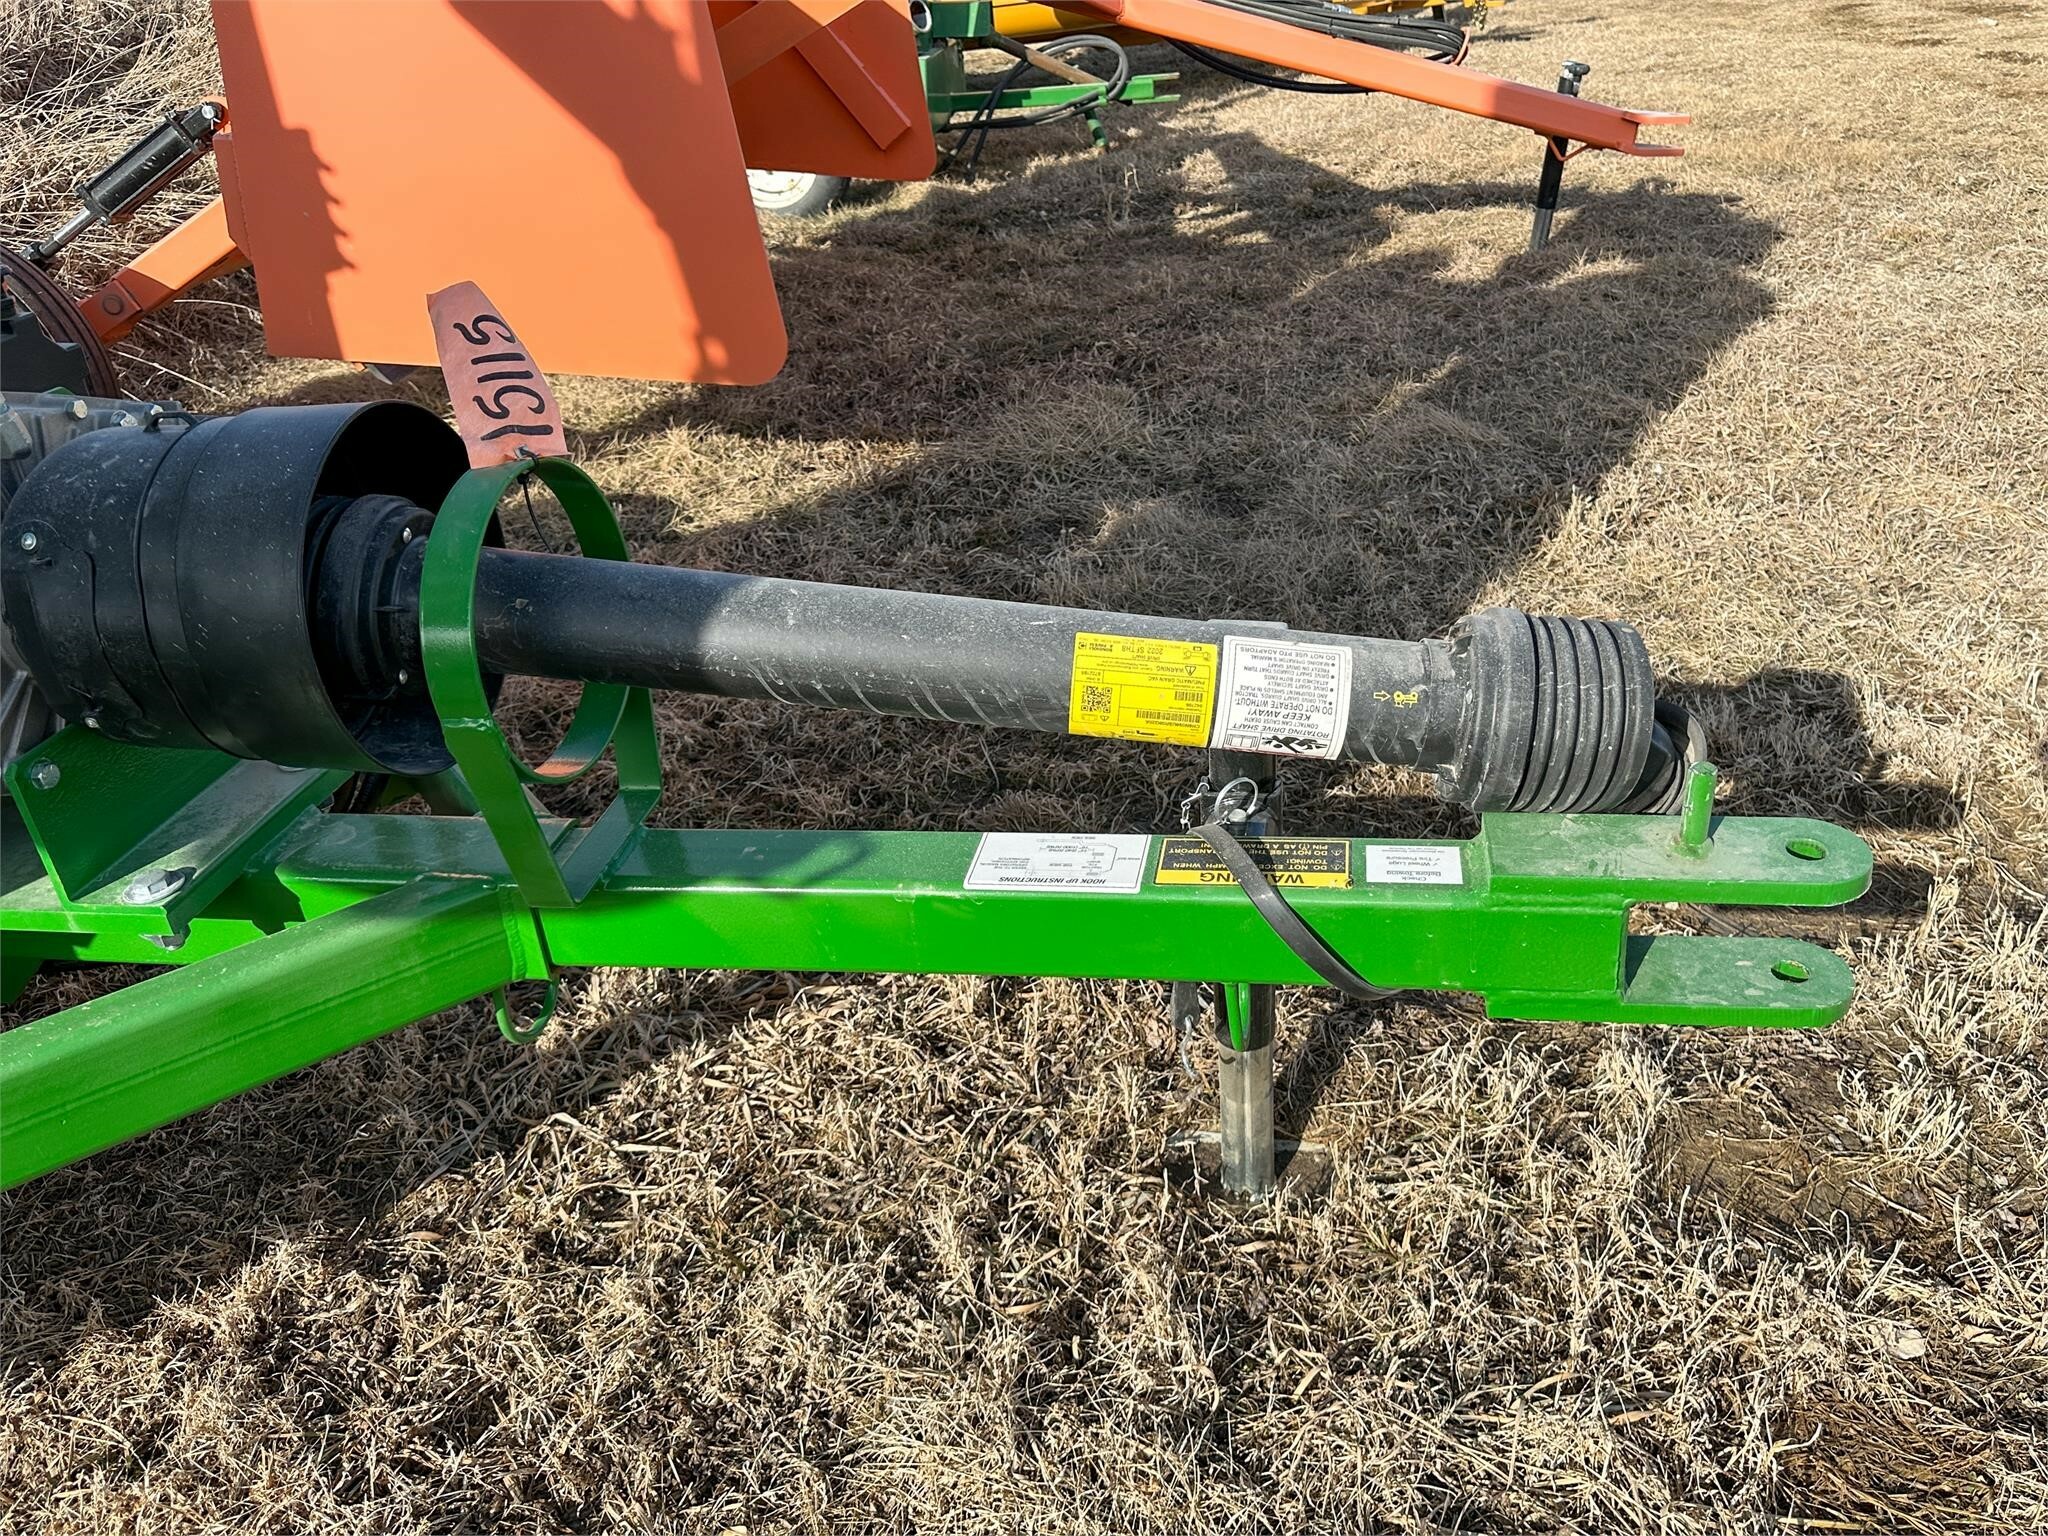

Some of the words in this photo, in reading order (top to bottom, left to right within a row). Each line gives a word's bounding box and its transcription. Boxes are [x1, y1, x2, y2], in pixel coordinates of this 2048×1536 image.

[453, 314, 554, 441] 15115
[1147, 647, 1163, 655] 2022
[1240, 647, 1277, 655] ADAPTORS
[1286, 690, 1315, 698] EQUIPMENT
[1271, 701, 1304, 711] OPERATE
[1306, 705, 1320, 713] NOT
[1248, 708, 1281, 718] AWAY!
[1322, 706, 1333, 715] DO
[1283, 712, 1311, 721] KEEP
[1233, 723, 1259, 731] SHAFT
[1261, 726, 1286, 734] DRIVE
[1288, 729, 1329, 738] ROTATING
